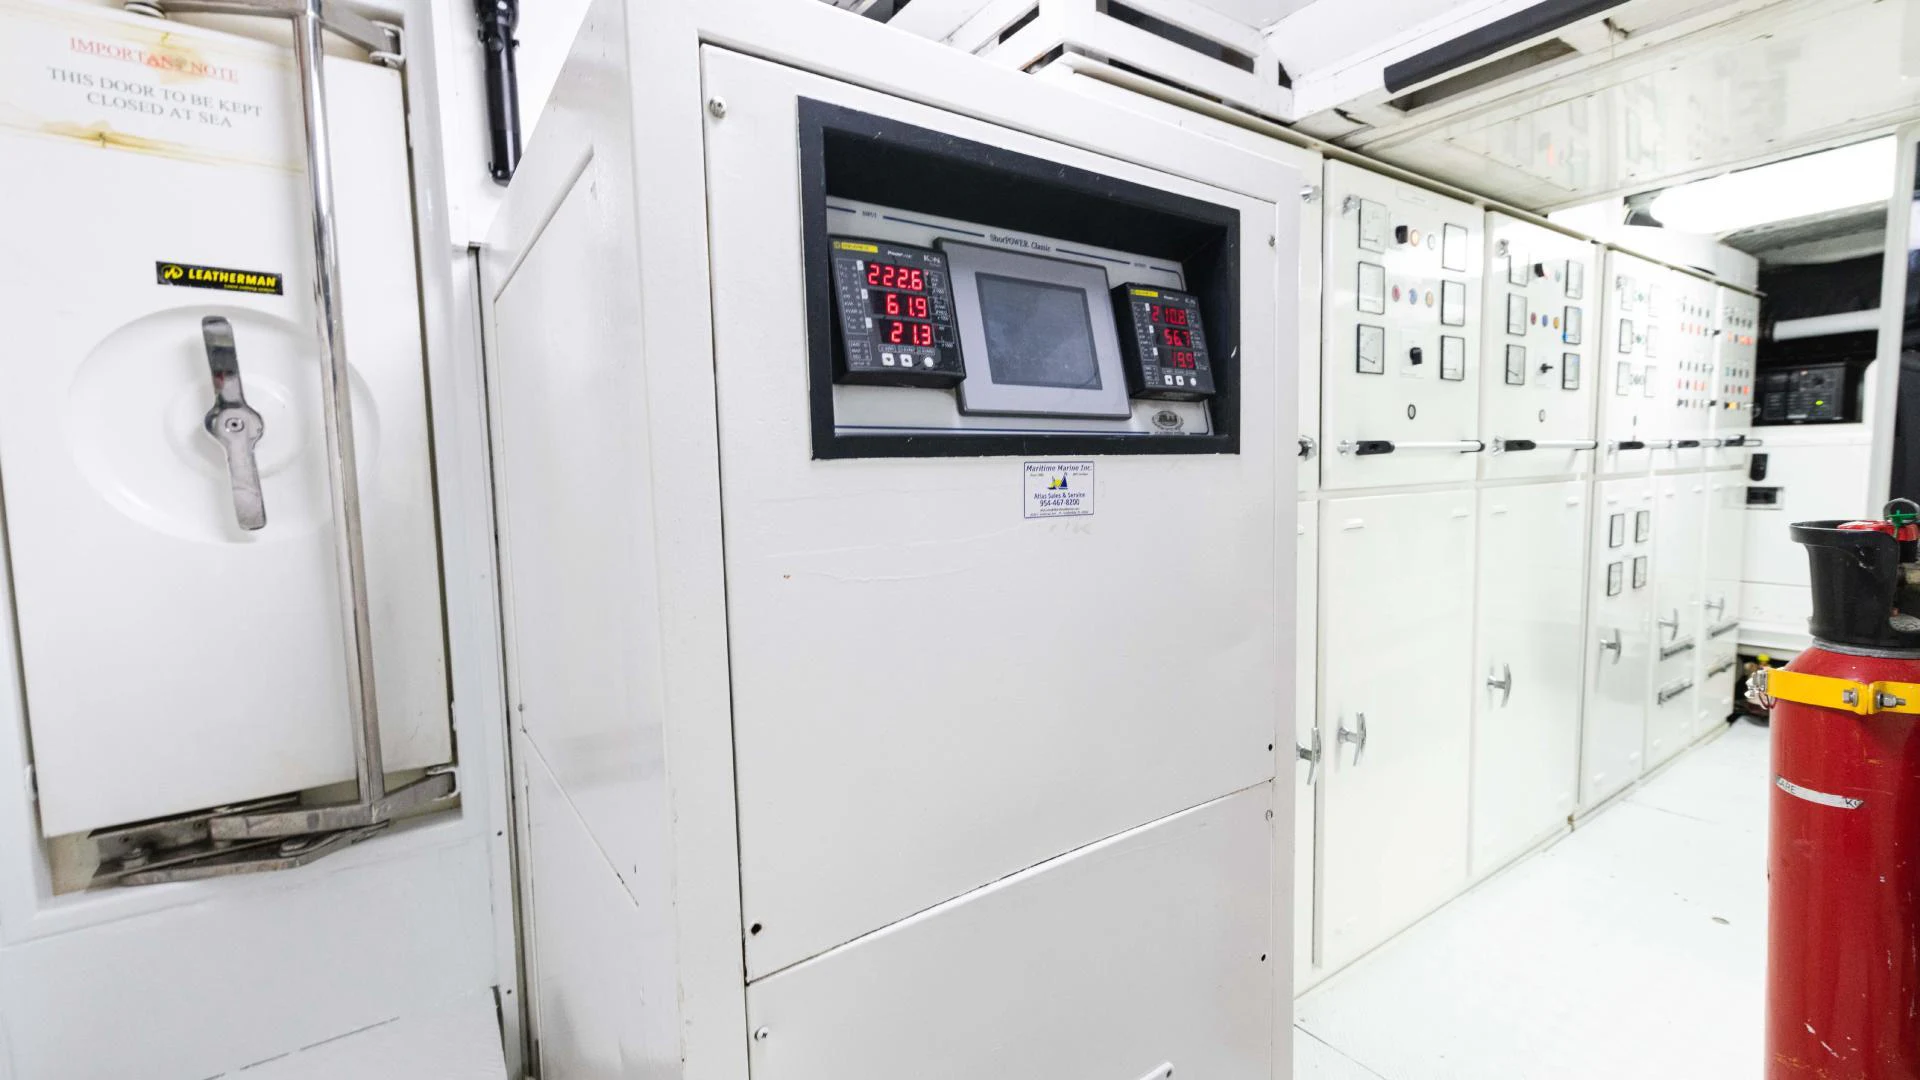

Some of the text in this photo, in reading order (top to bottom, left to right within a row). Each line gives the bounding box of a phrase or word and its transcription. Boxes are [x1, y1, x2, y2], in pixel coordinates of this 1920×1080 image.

[190, 62, 239, 83] NOTE
[47, 67, 262, 117] THIS DOOR TO BE KEPT
[86, 92, 233, 128] CLOSED AT SEA
[188, 268, 276, 287] LEATHERMAN
[868, 263, 923, 291] 222.6
[887, 293, 927, 318] 61.9
[891, 321, 931, 346] 21.3
[1026, 464, 1056, 472] Maritime
[1057, 464, 1079, 472] Marine
